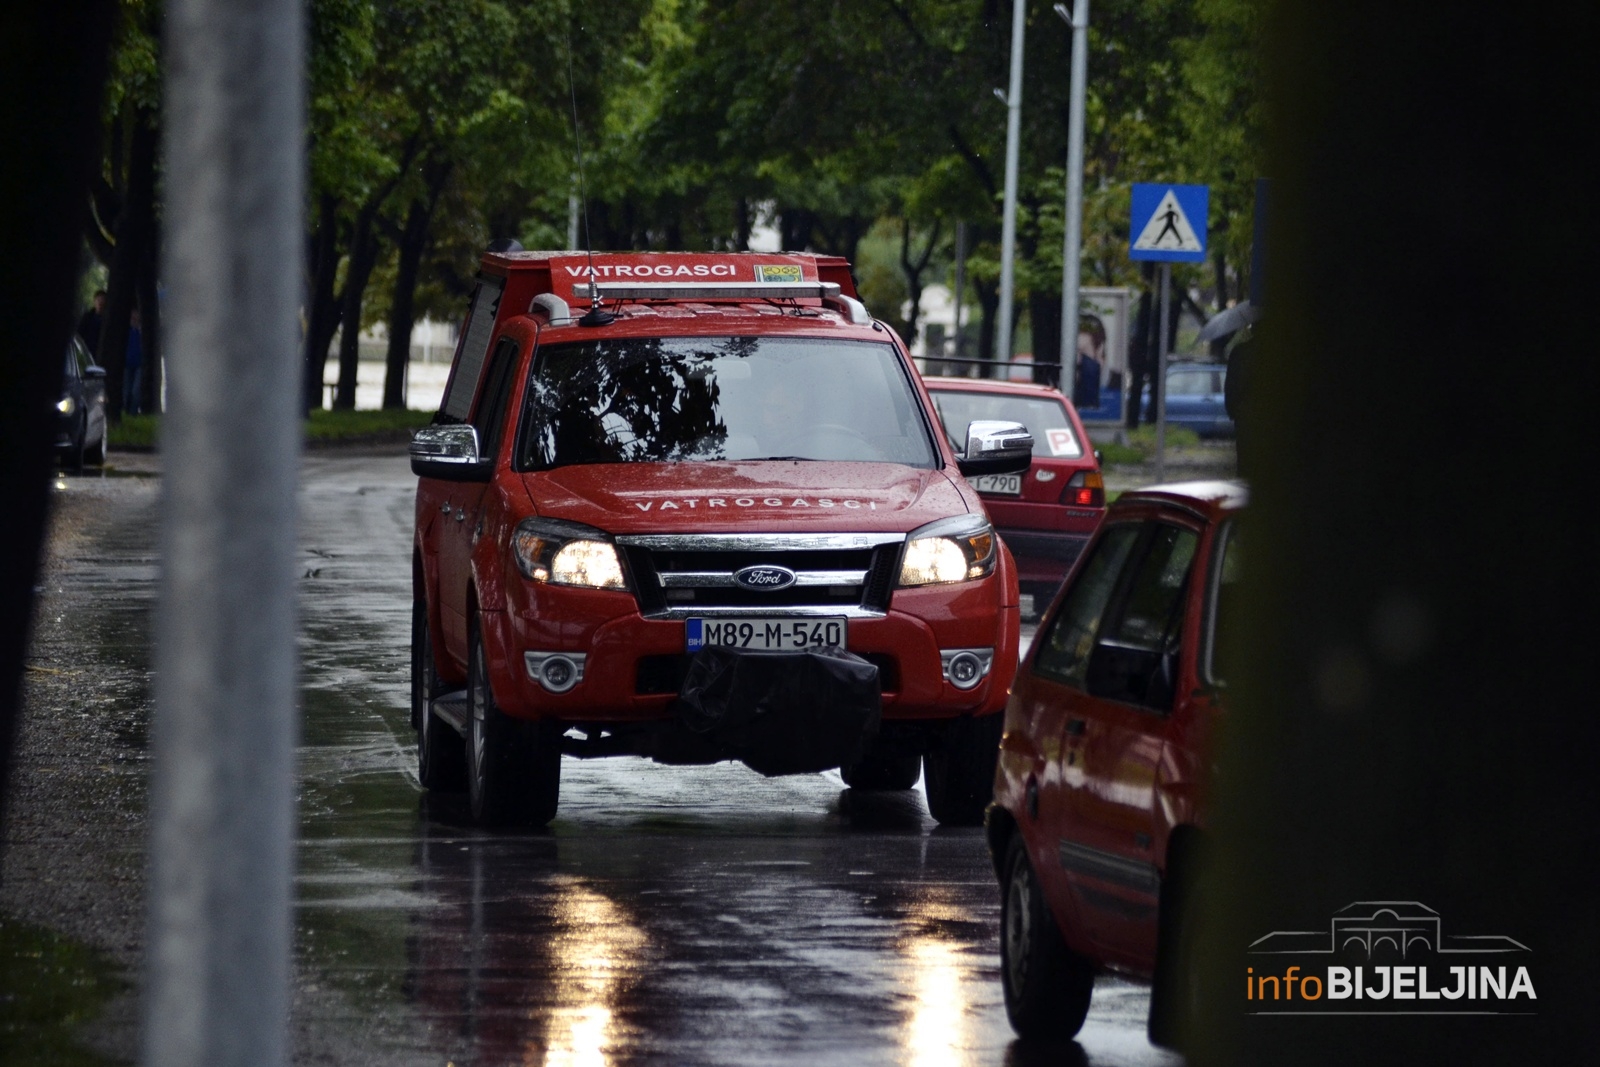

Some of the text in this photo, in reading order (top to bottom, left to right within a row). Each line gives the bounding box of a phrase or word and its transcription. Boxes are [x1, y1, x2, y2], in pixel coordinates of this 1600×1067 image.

[565, 264, 736, 277] VATROGASCI
[1049, 432, 1070, 452] P
[636, 498, 877, 512] VATROGASCI
[748, 570, 781, 584] Ford
[705, 622, 840, 648] M89-M-540
